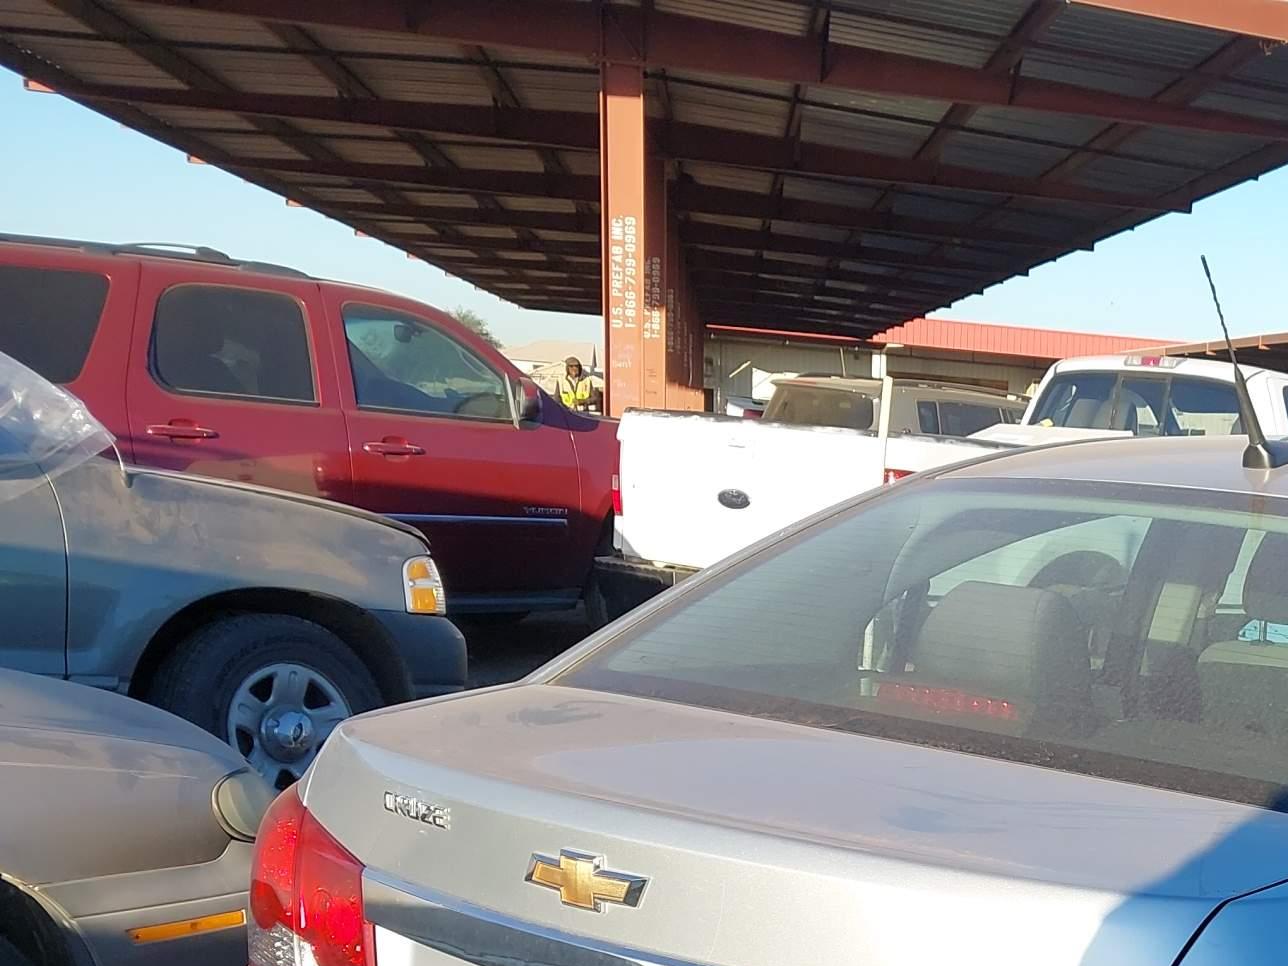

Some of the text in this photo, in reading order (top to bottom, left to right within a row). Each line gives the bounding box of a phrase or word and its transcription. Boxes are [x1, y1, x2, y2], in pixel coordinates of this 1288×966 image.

[611, 214, 625, 329] U.S. PREFAB INC.
[624, 215, 637, 329] 1-866-799-0969
[383, 791, 451, 830] CRUZE
